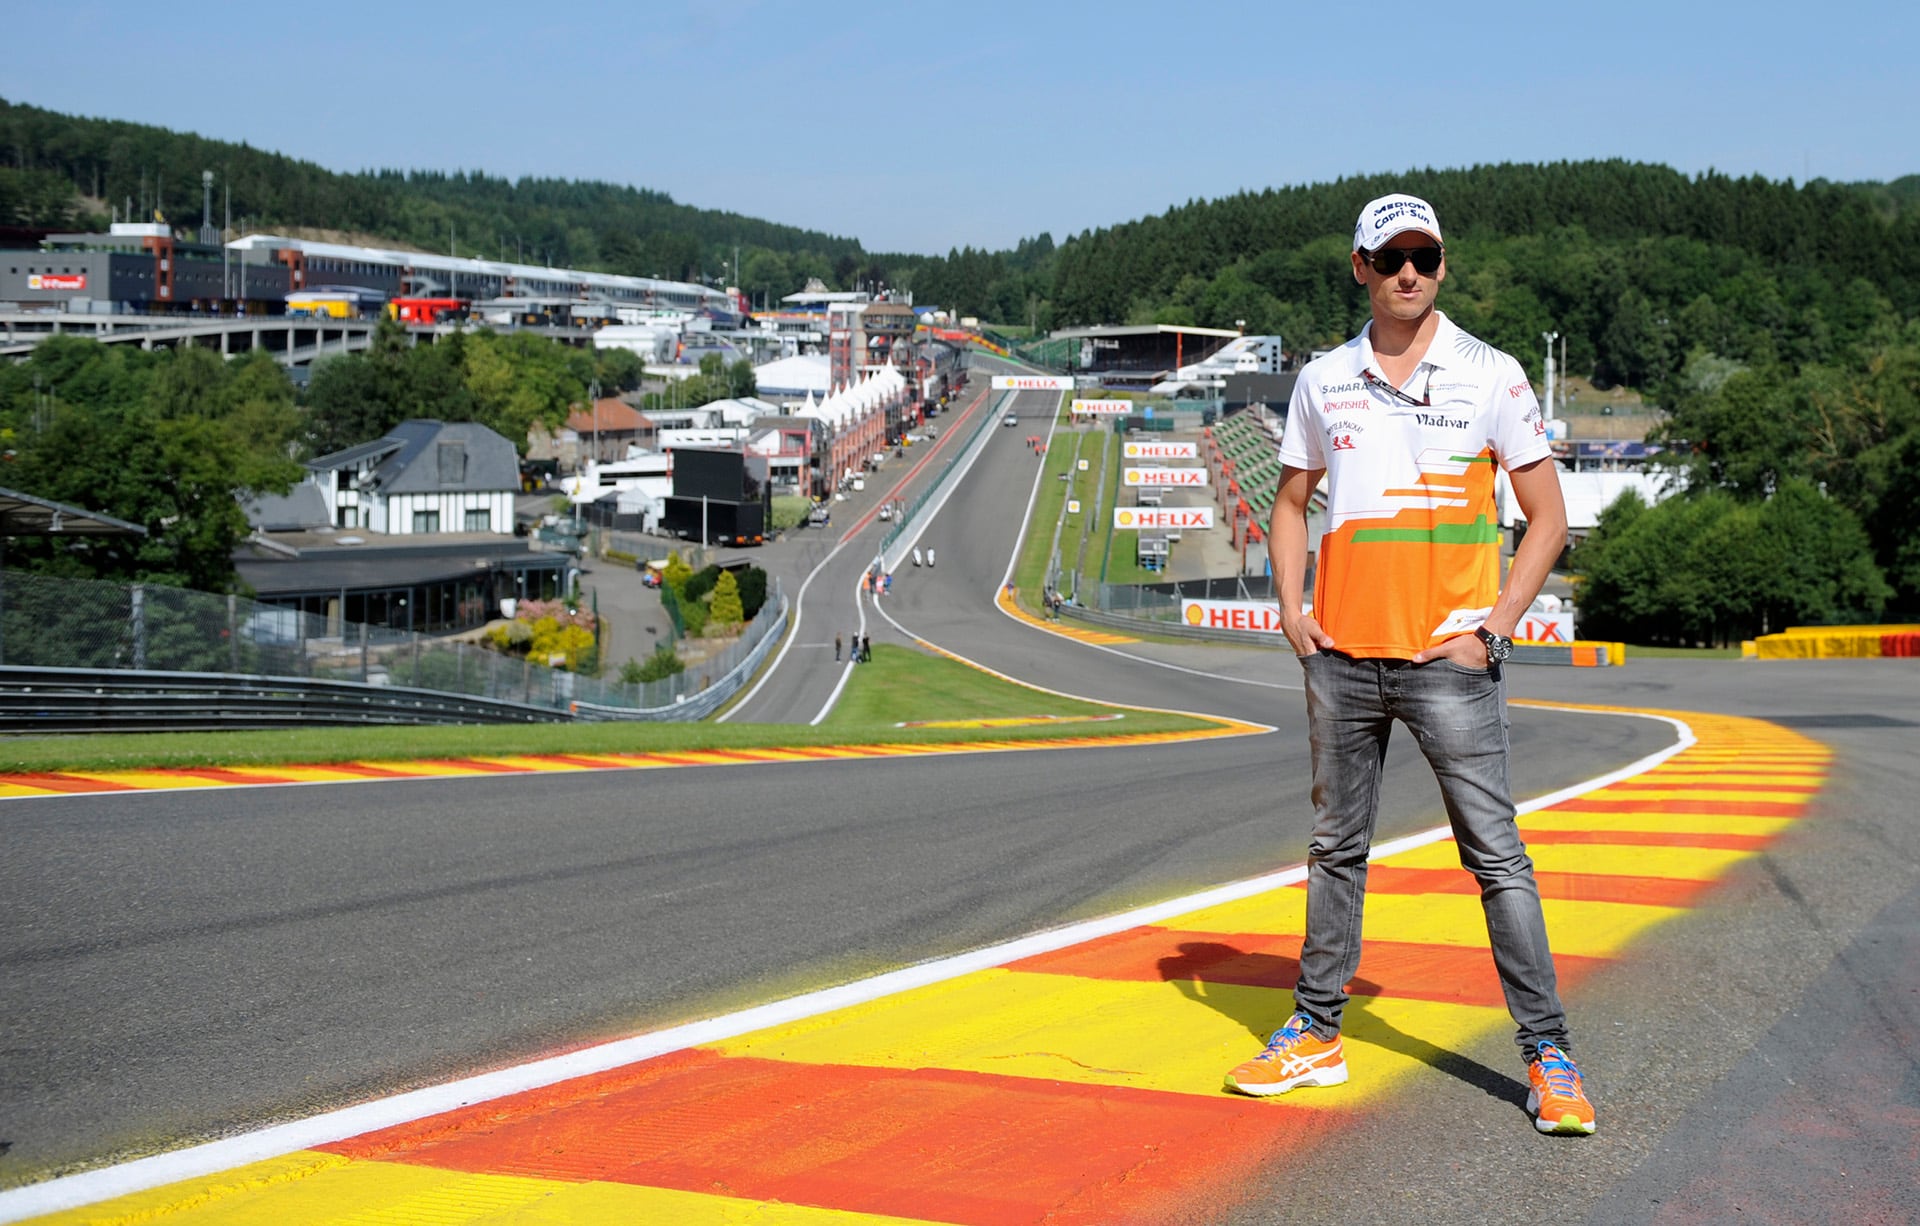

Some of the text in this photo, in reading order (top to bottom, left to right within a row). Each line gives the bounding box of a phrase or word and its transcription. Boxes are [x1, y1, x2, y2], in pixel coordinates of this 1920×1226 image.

[1374, 202, 1426, 216] MEDION
[1375, 208, 1430, 229] Capri-Sun
[1018, 380, 1057, 389] HELIX
[1322, 382, 1369, 394] SAHARA
[1323, 400, 1370, 414] KINGFISHER
[1416, 414, 1469, 429] Vladivar
[1142, 447, 1191, 456] HELIX
[1144, 473, 1201, 483] HELIX
[1138, 513, 1206, 525] HELIX
